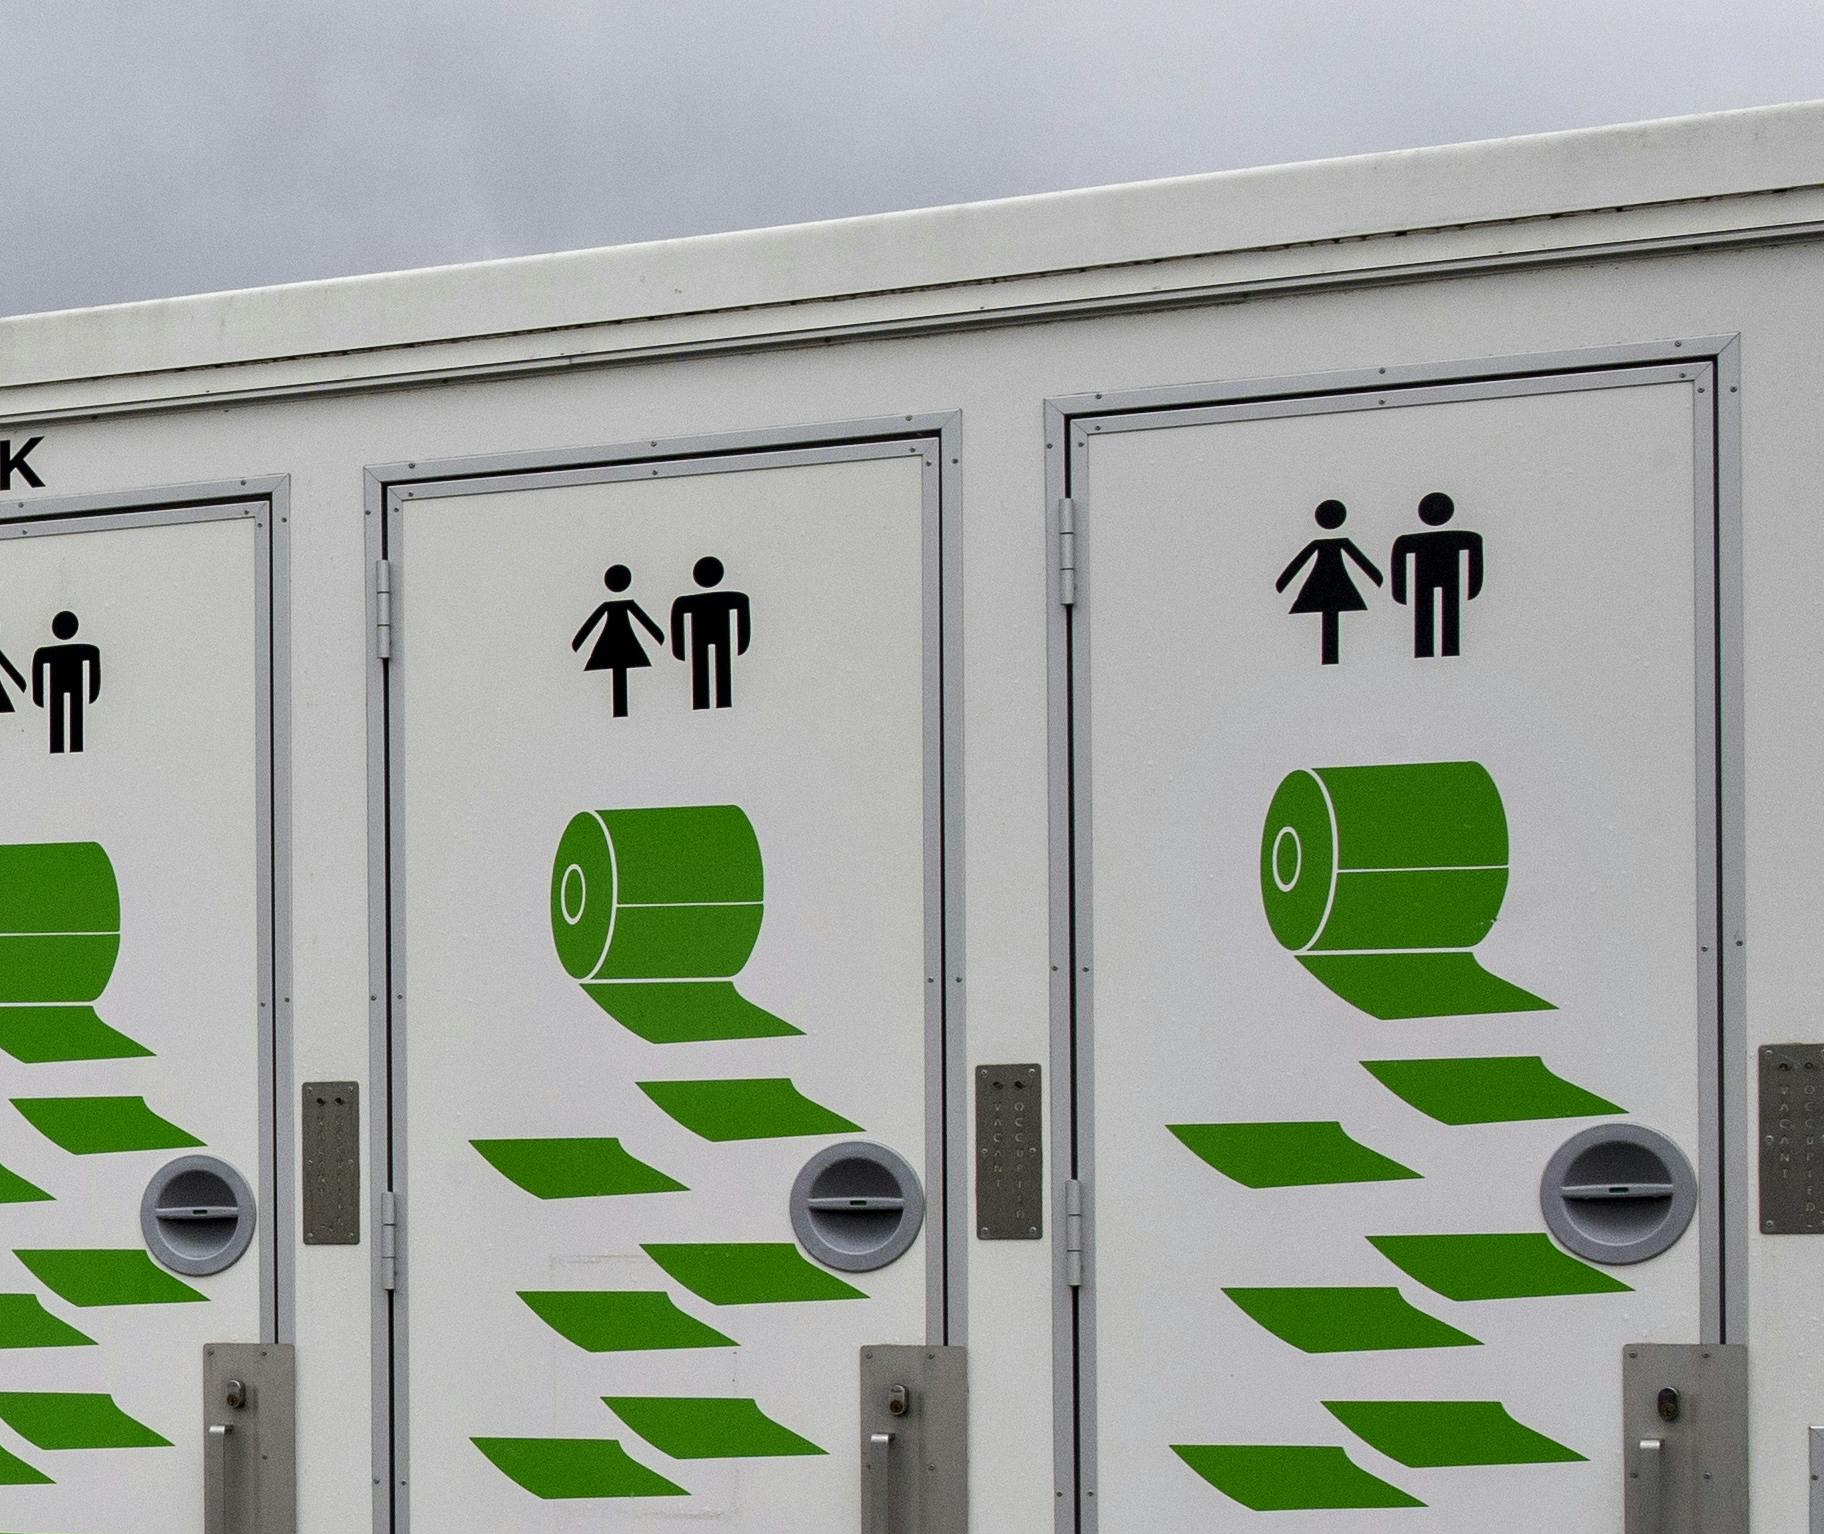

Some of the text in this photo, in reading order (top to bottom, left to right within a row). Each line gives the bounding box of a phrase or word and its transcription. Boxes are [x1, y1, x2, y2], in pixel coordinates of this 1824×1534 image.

[992, 1100, 1004, 1189] VACANT
[1778, 1084, 1792, 1180] VACANT
[1803, 1084, 1816, 1212] OCCUPIED
